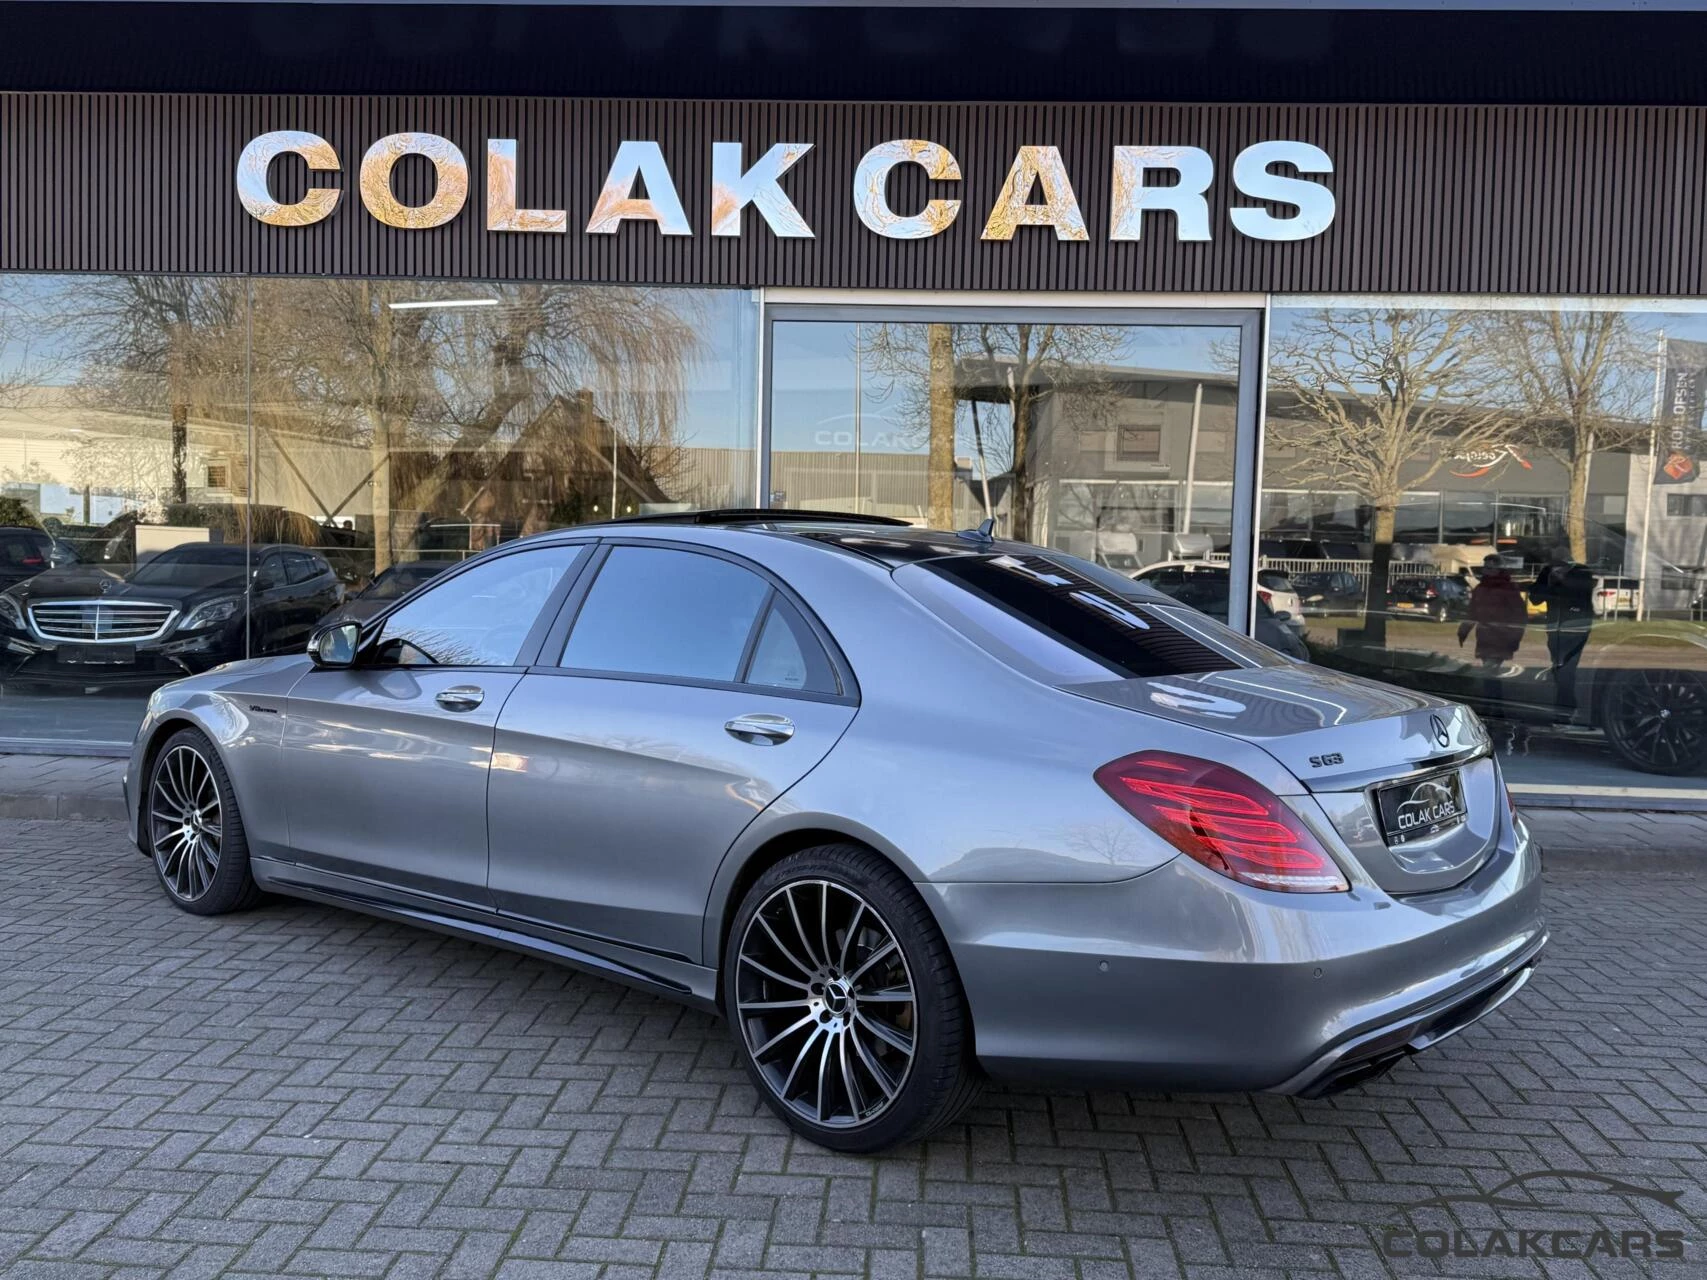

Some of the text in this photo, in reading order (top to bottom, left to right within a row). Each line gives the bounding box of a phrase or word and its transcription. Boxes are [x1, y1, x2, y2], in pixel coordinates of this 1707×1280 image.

[236, 130, 1336, 242] COLAK CARS
[1397, 801, 1455, 830] COLAK CARS
